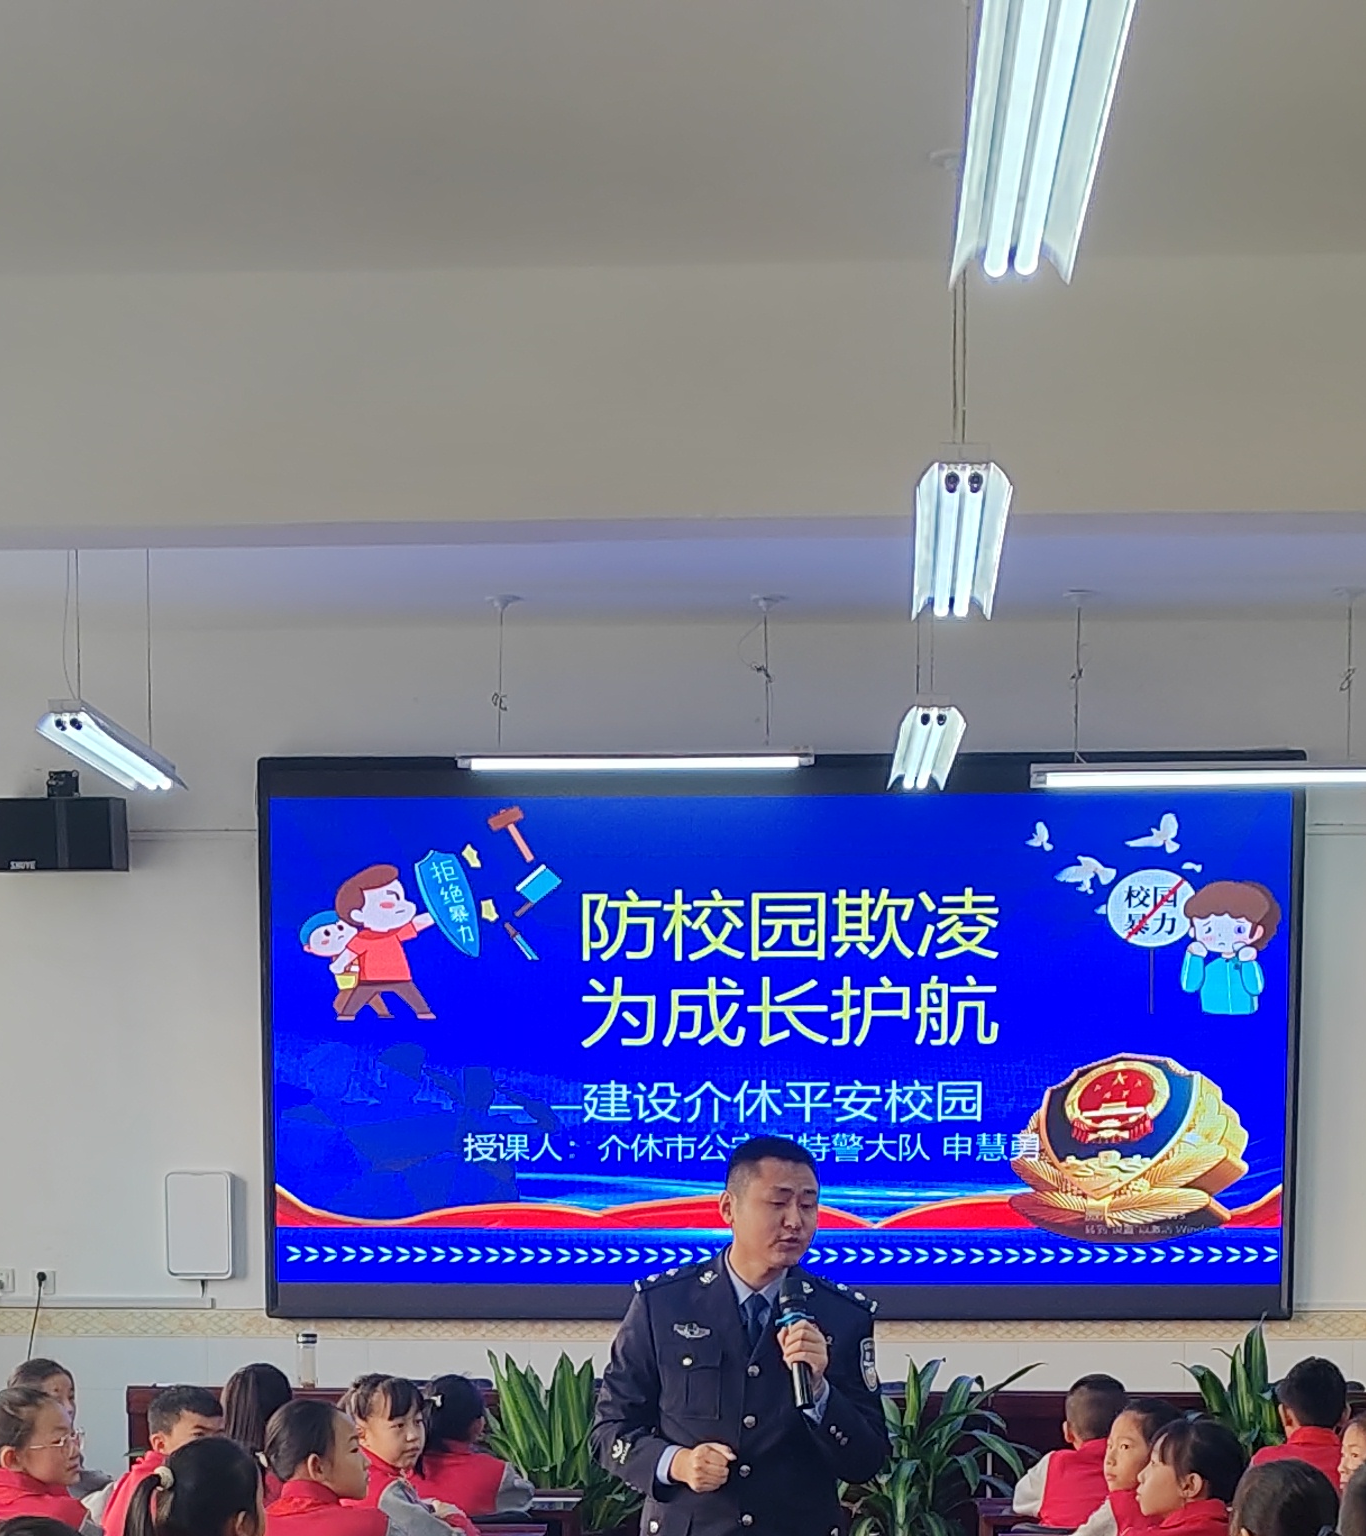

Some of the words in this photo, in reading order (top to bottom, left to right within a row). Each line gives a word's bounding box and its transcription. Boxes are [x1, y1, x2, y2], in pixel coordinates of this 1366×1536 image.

[430, 859, 475, 944] 拒绝暴力
[582, 887, 999, 962] 防校园欺凌
[581, 975, 999, 1048] 为成长护航
[942, 1132, 1040, 1162] 申慧勇
